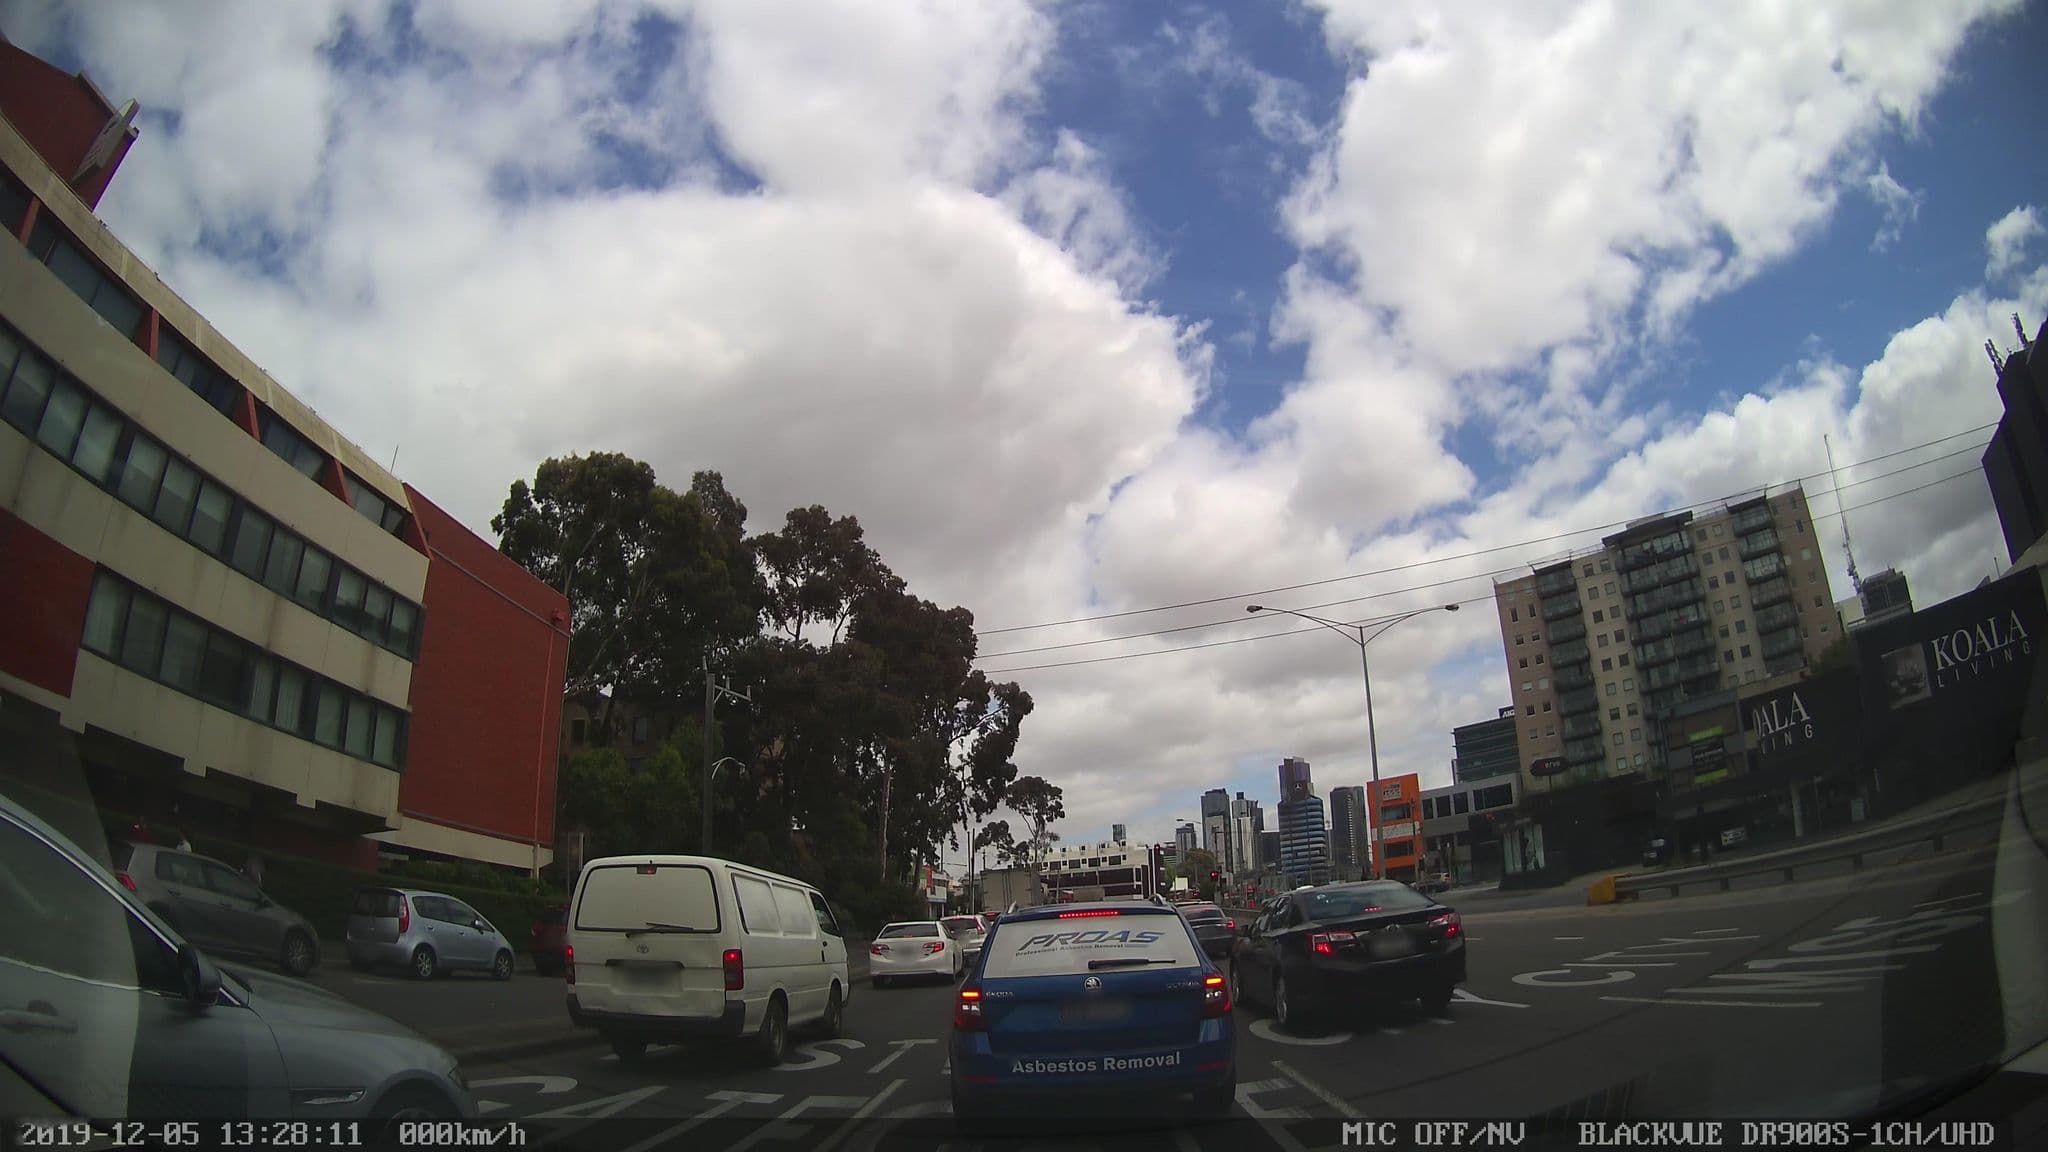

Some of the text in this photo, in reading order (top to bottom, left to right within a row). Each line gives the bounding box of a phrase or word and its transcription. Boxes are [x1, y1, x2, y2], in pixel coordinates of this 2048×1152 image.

[1930, 608, 2029, 671] KOALA
[1936, 641, 2031, 688] LIVING
[1752, 690, 1811, 737] OALA
[1015, 946, 1058, 957] Professional
[1017, 929, 1166, 951] PROAS
[1511, 935, 1761, 987] CITY
[1012, 1051, 1181, 1074] Asbestos Removal
